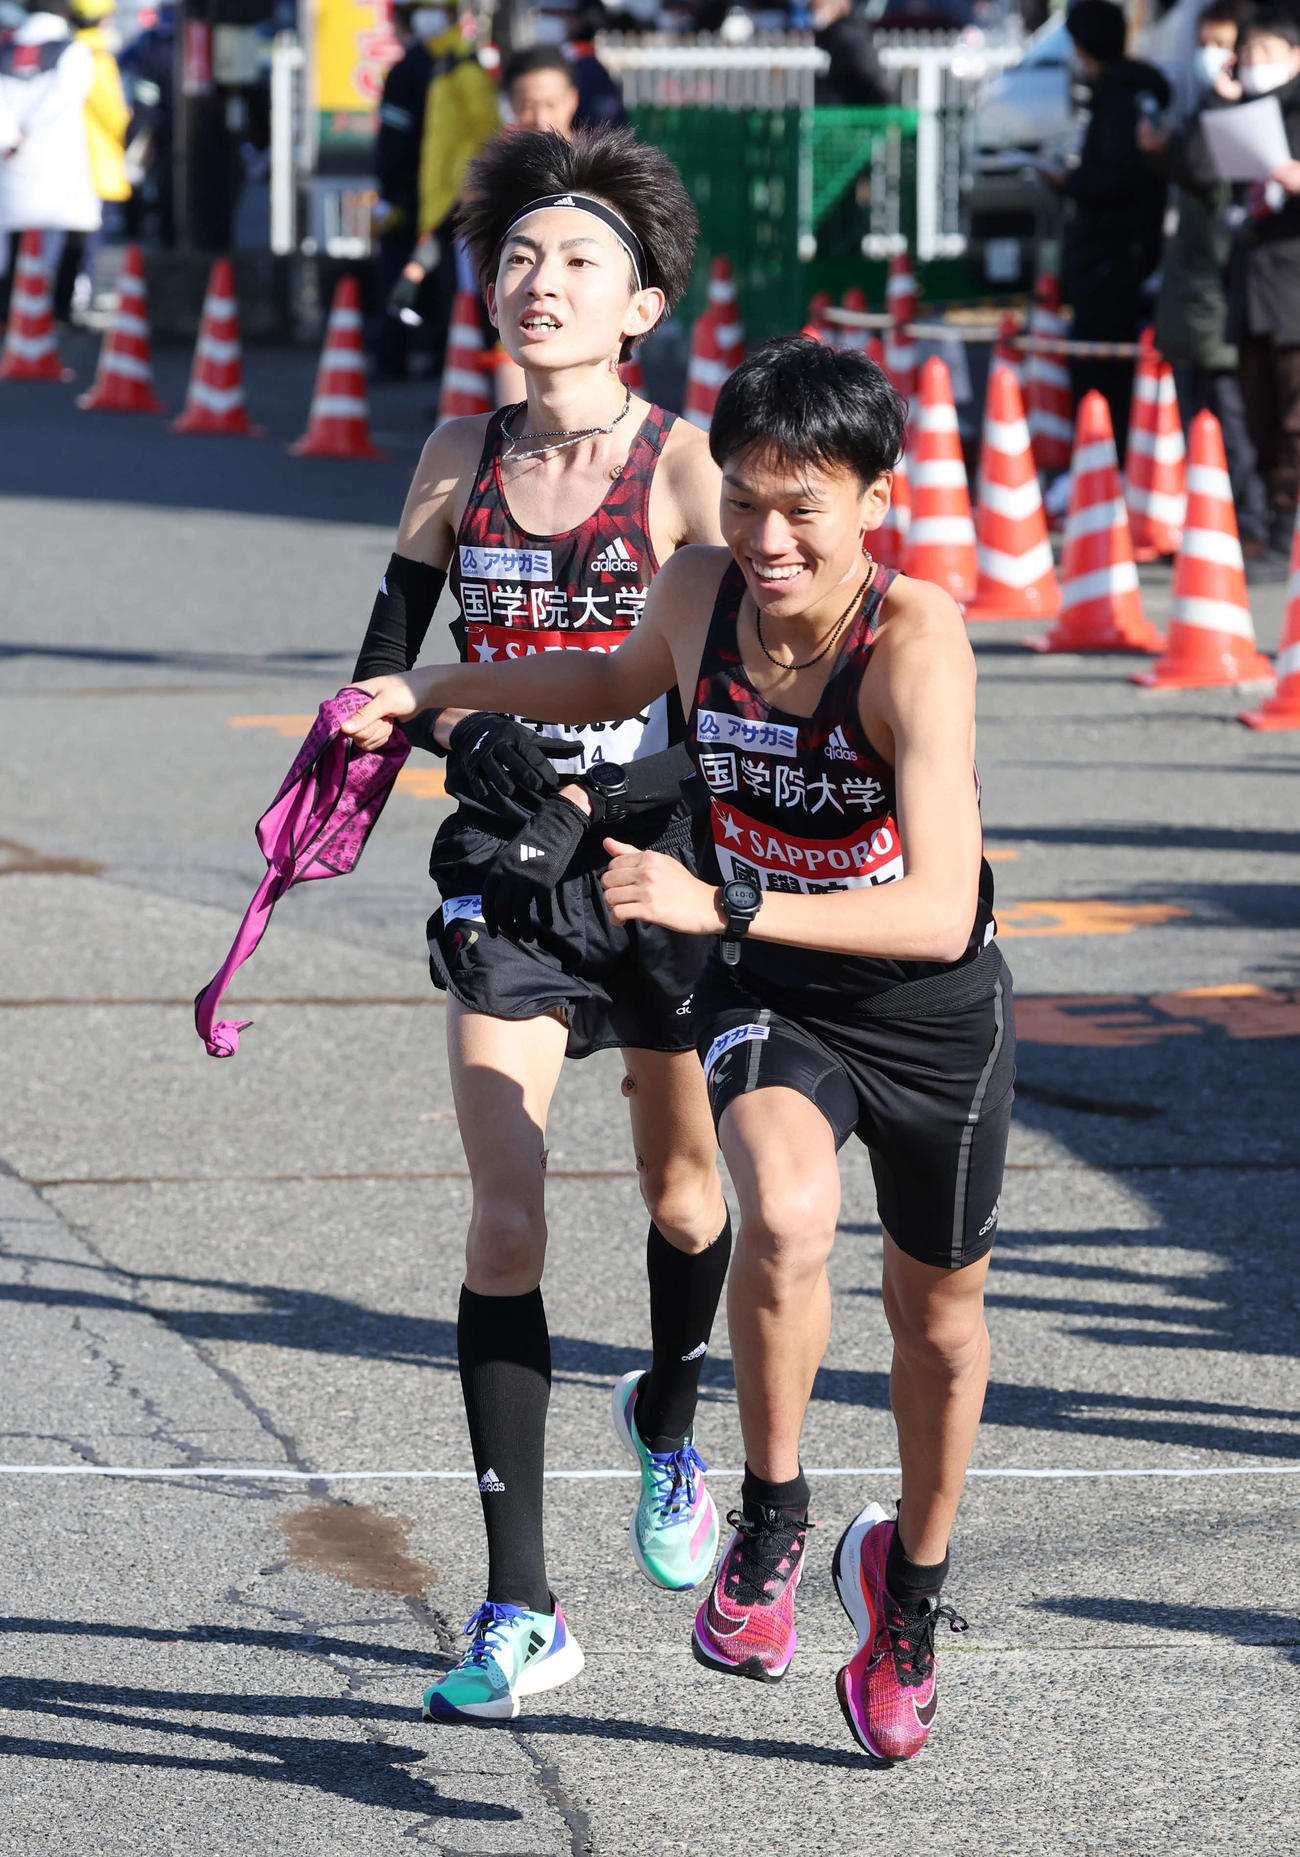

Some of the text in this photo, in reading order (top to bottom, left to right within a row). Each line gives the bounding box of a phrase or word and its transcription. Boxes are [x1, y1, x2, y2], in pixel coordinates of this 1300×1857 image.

[484, 552, 549, 574] アサガミ
[590, 558, 638, 572] adidas
[459, 582, 648, 629] 国学院大学
[727, 719, 794, 749] アサガミ
[699, 752, 886, 815] 国学院大学
[750, 827, 893, 871] SAPPORO
